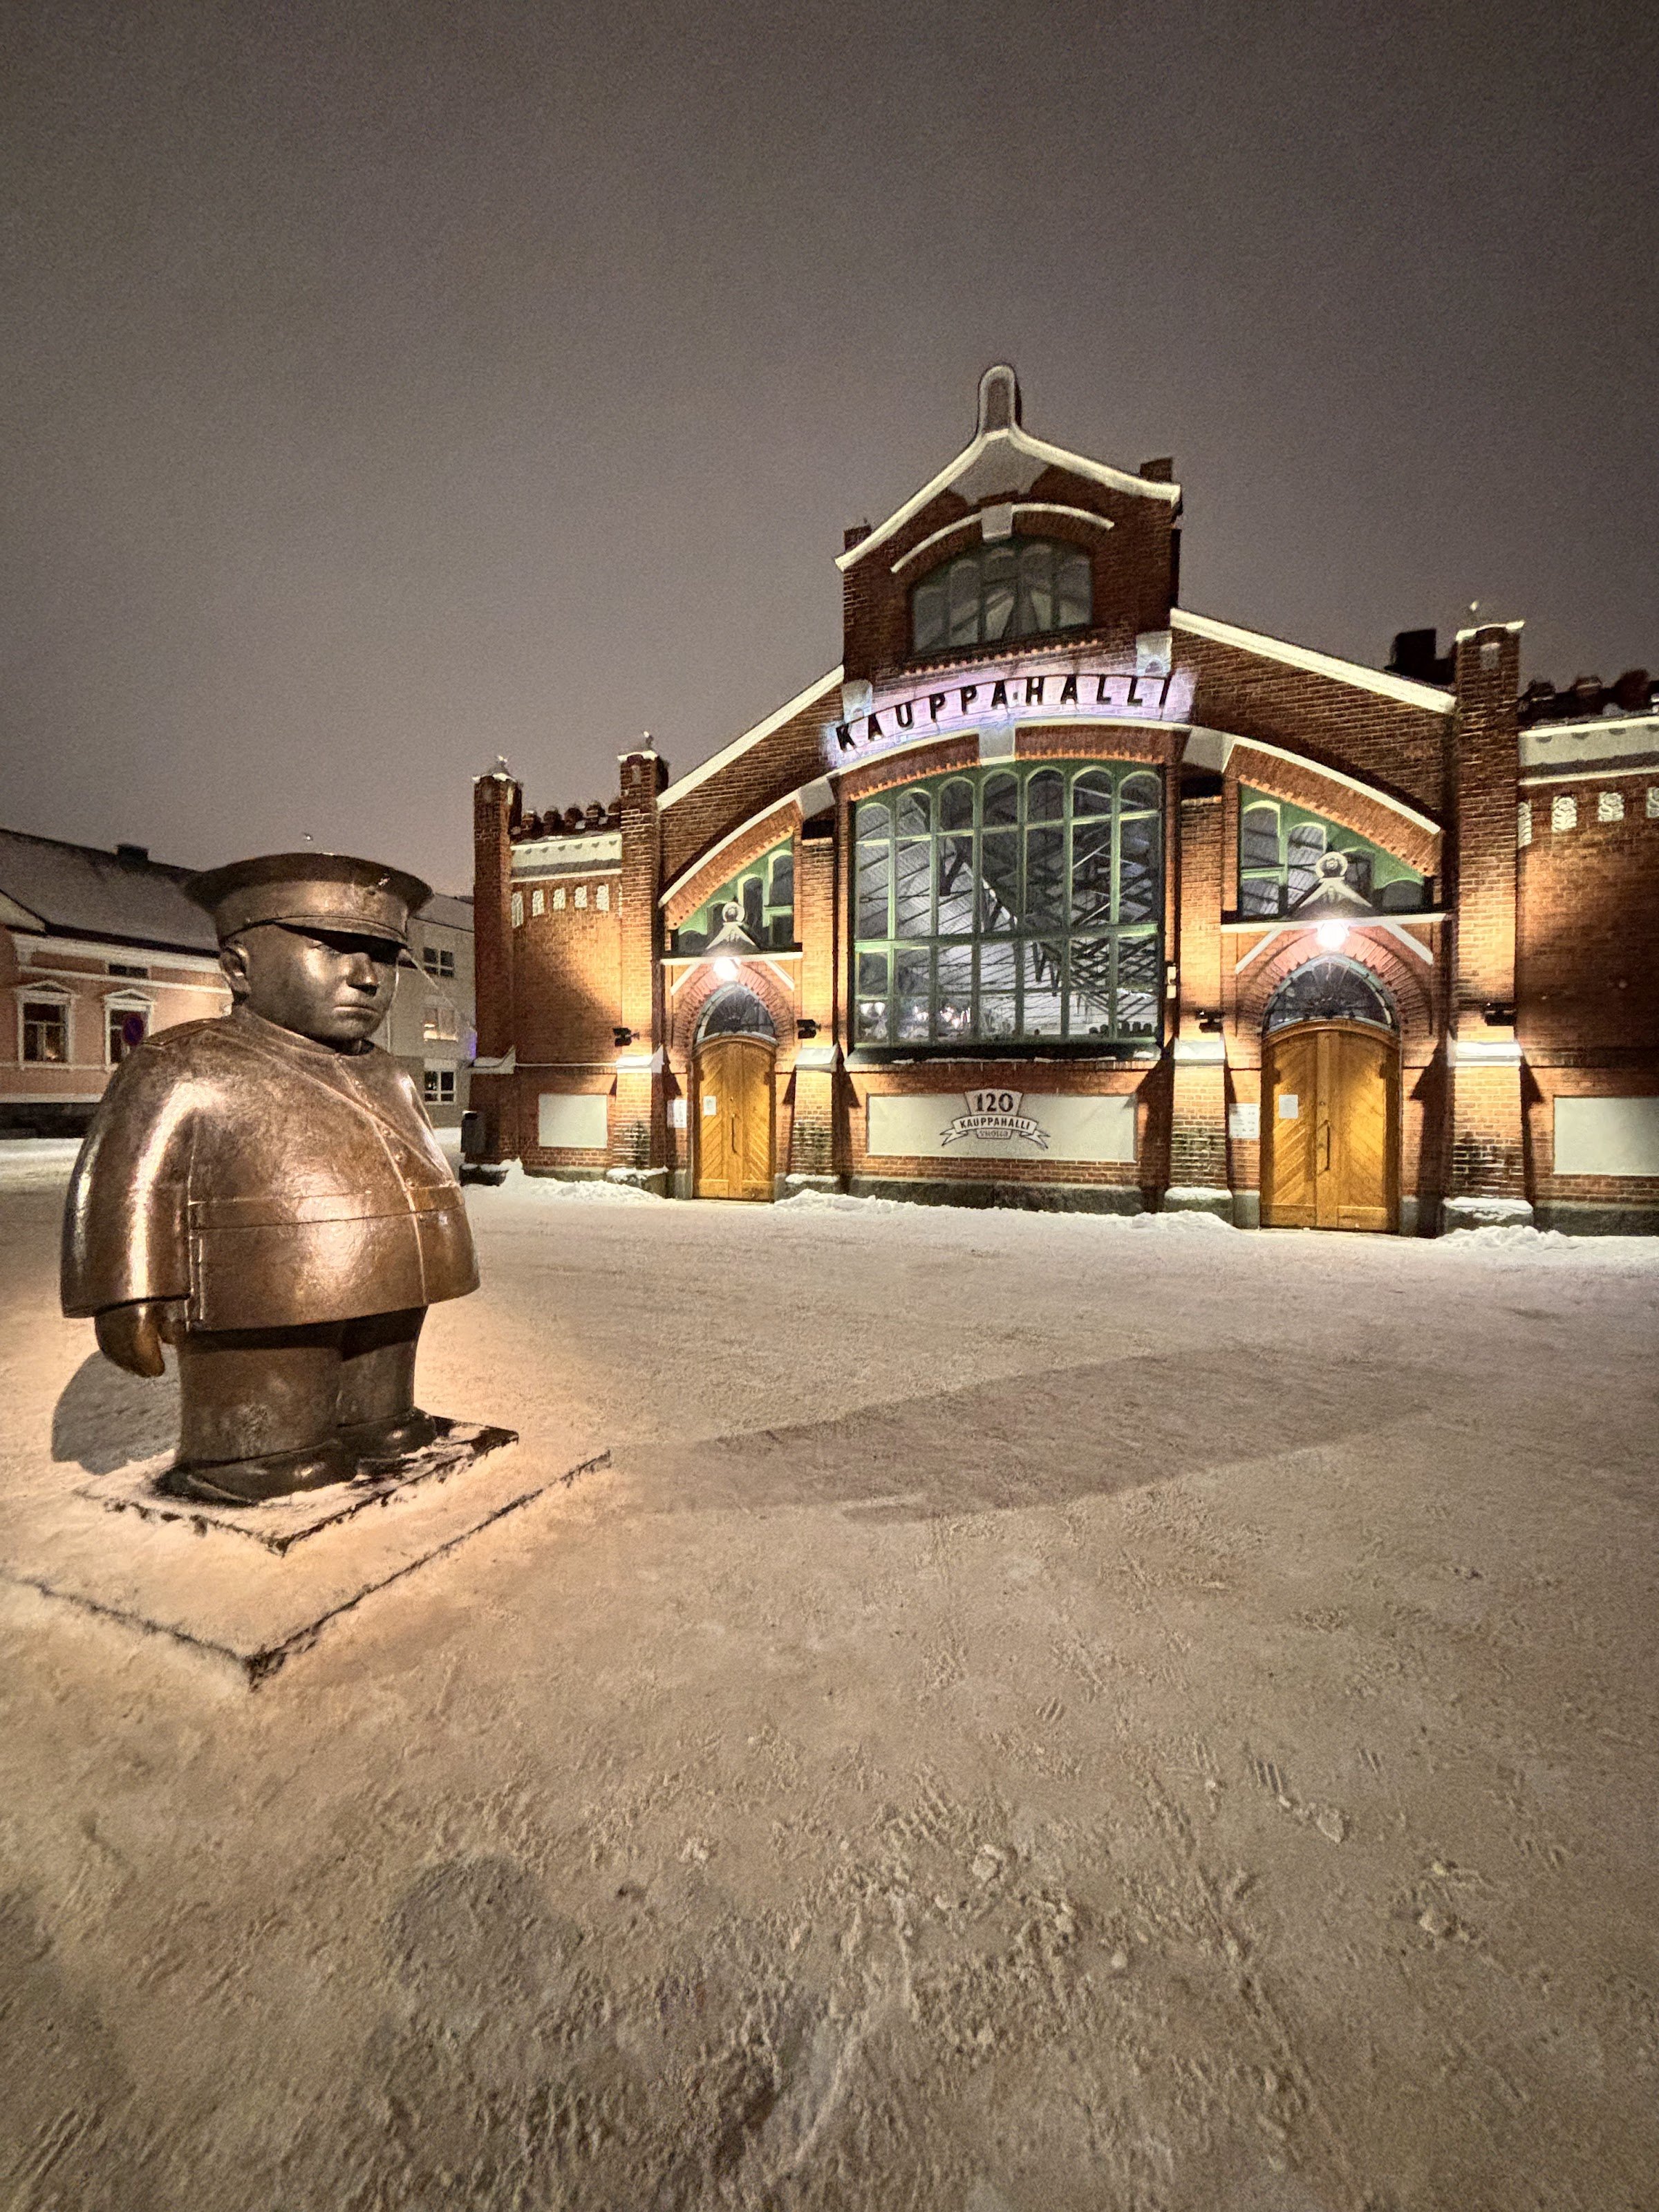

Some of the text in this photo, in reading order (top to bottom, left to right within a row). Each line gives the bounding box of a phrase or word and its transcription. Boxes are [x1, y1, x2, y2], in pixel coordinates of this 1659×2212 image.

[836, 673, 1170, 750] KAUPPAHALLI
[975, 1093, 1013, 1112] 120
[960, 1117, 1030, 1130] KAUPPAHALLI
